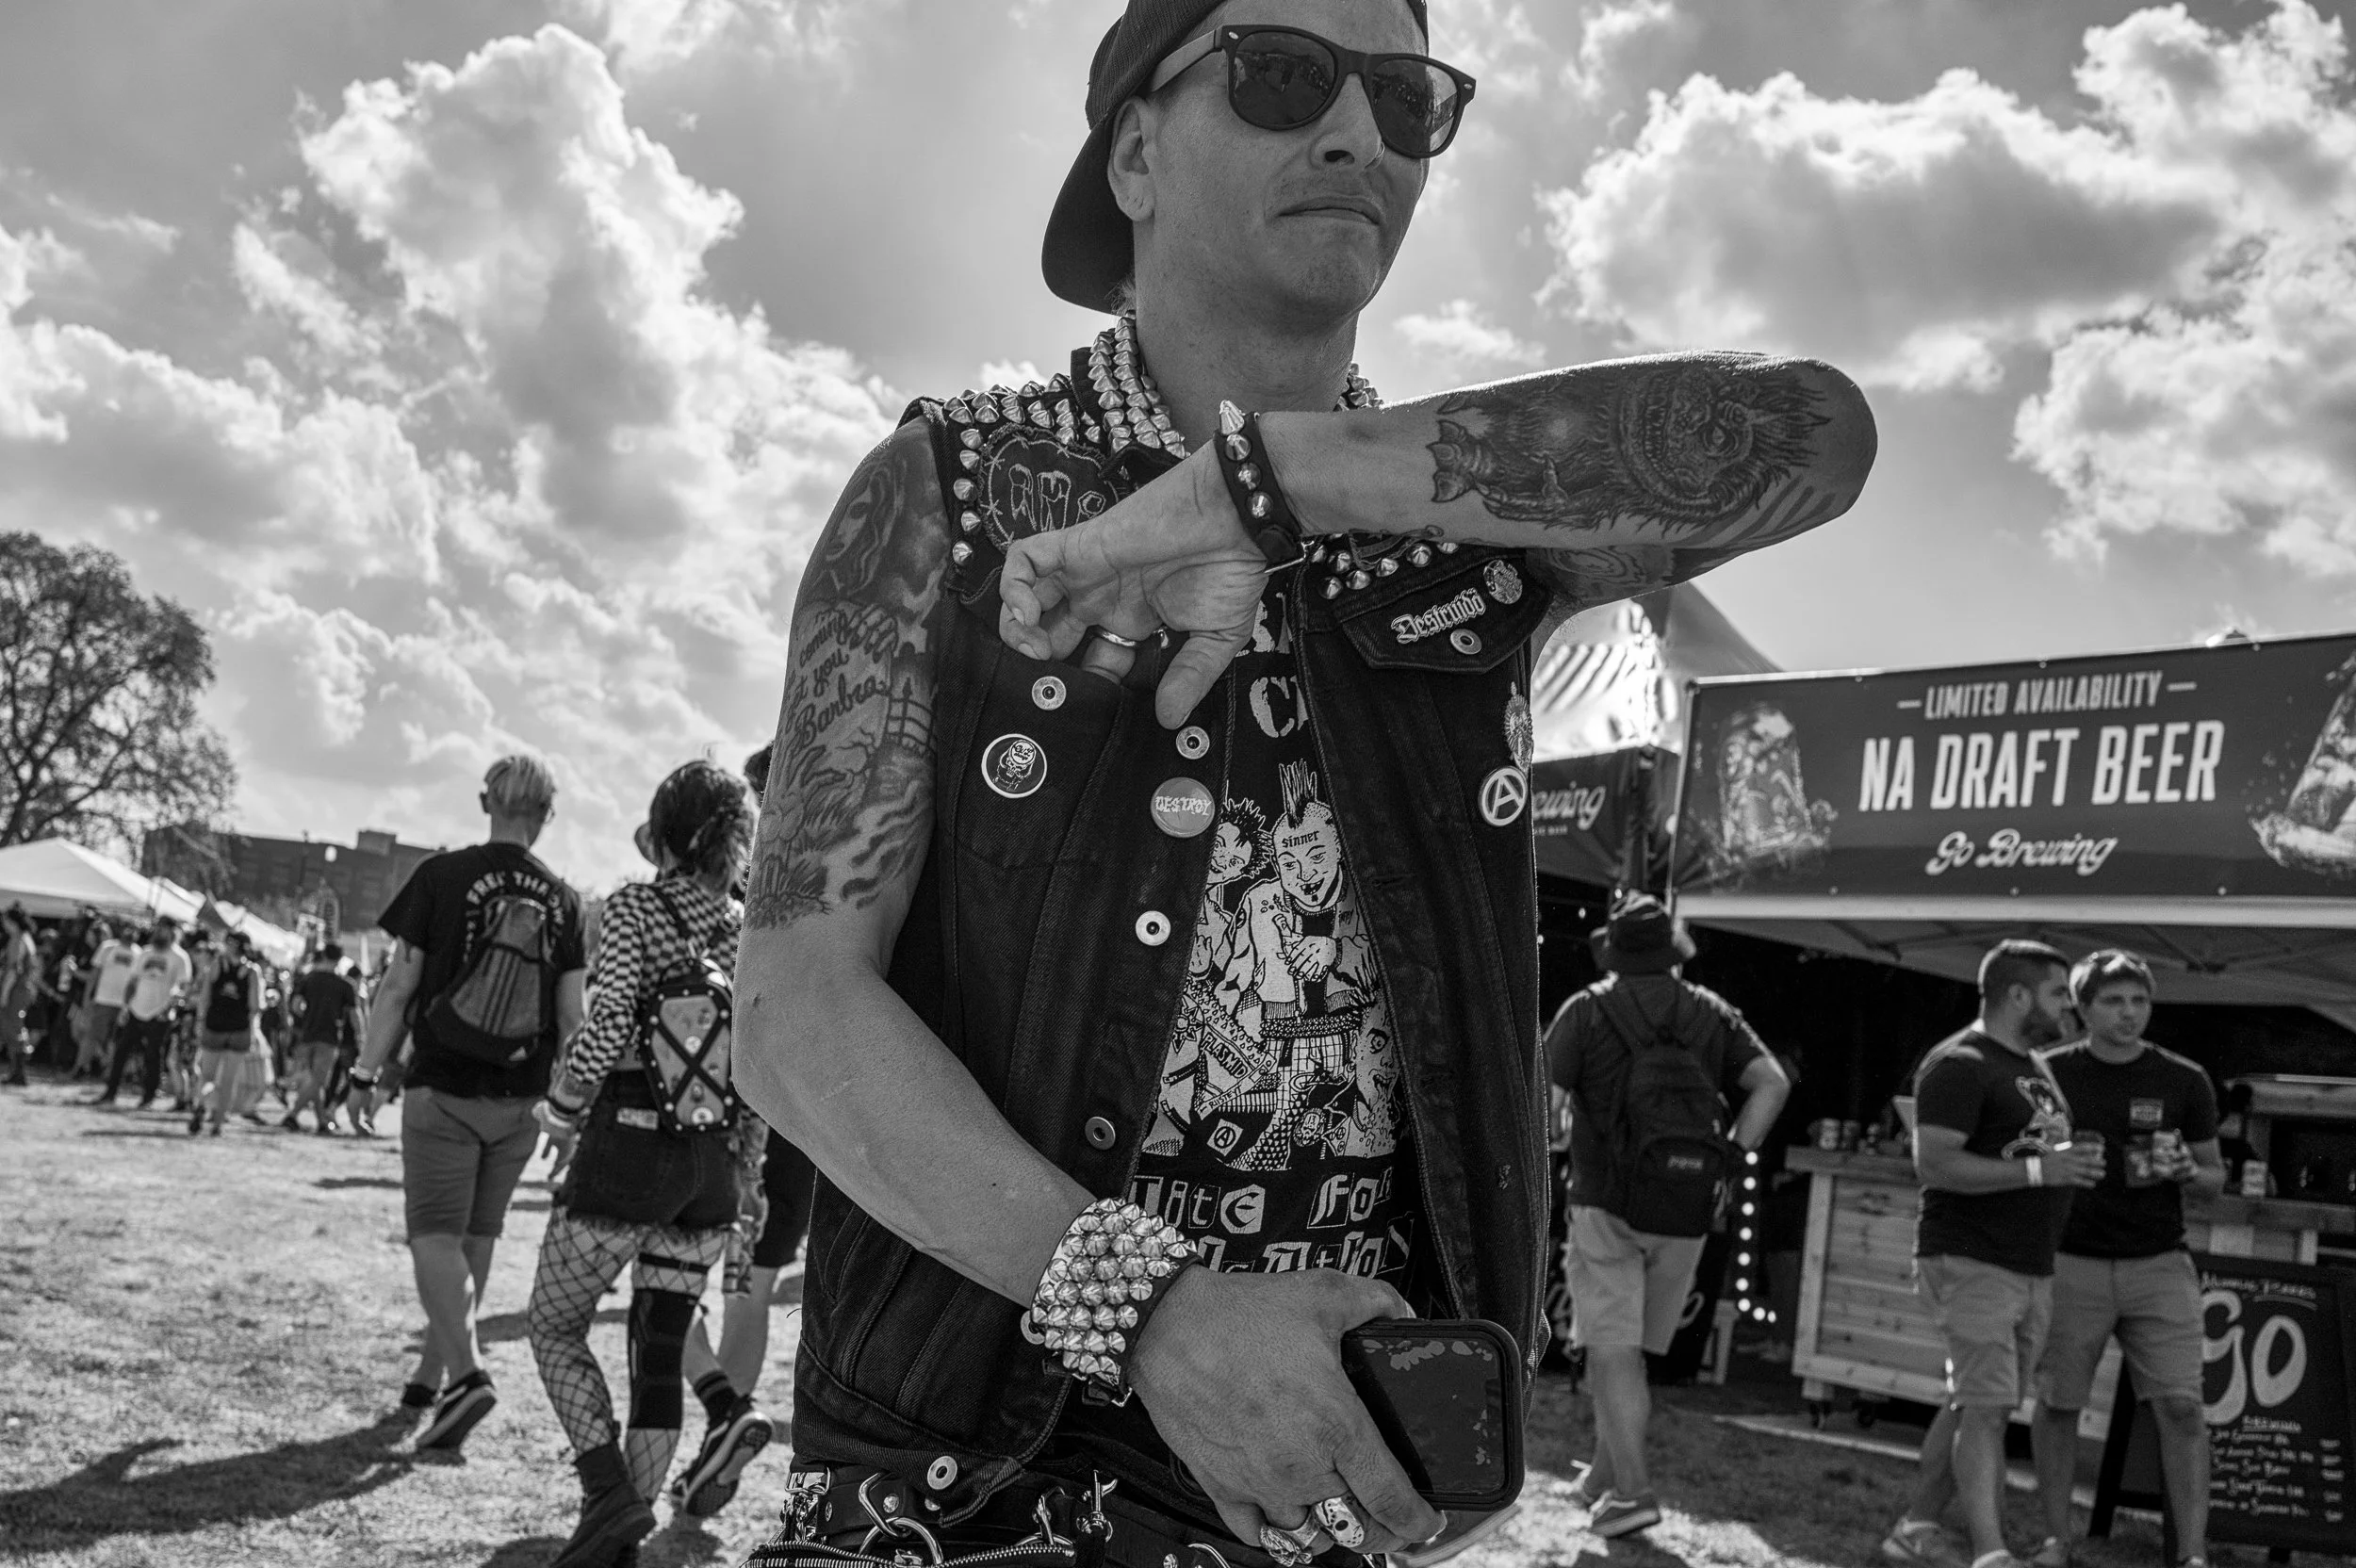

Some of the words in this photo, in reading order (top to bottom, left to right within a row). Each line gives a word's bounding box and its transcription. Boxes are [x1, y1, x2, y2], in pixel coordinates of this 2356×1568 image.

[1924, 682, 2009, 720] LIMITED
[2013, 670, 2164, 715] AVAILABILITY
[1858, 736, 1915, 811] NA
[1930, 727, 2081, 809] DRAFT
[2091, 720, 2225, 805] BEER
[1154, 795, 1212, 816] DESTROY
[1532, 780, 1607, 831] ewing
[1281, 830, 1320, 848] sinner
[1924, 830, 1975, 876] Go
[1973, 827, 2119, 876] Brewing
[1201, 1032, 1249, 1079] PLASMID
